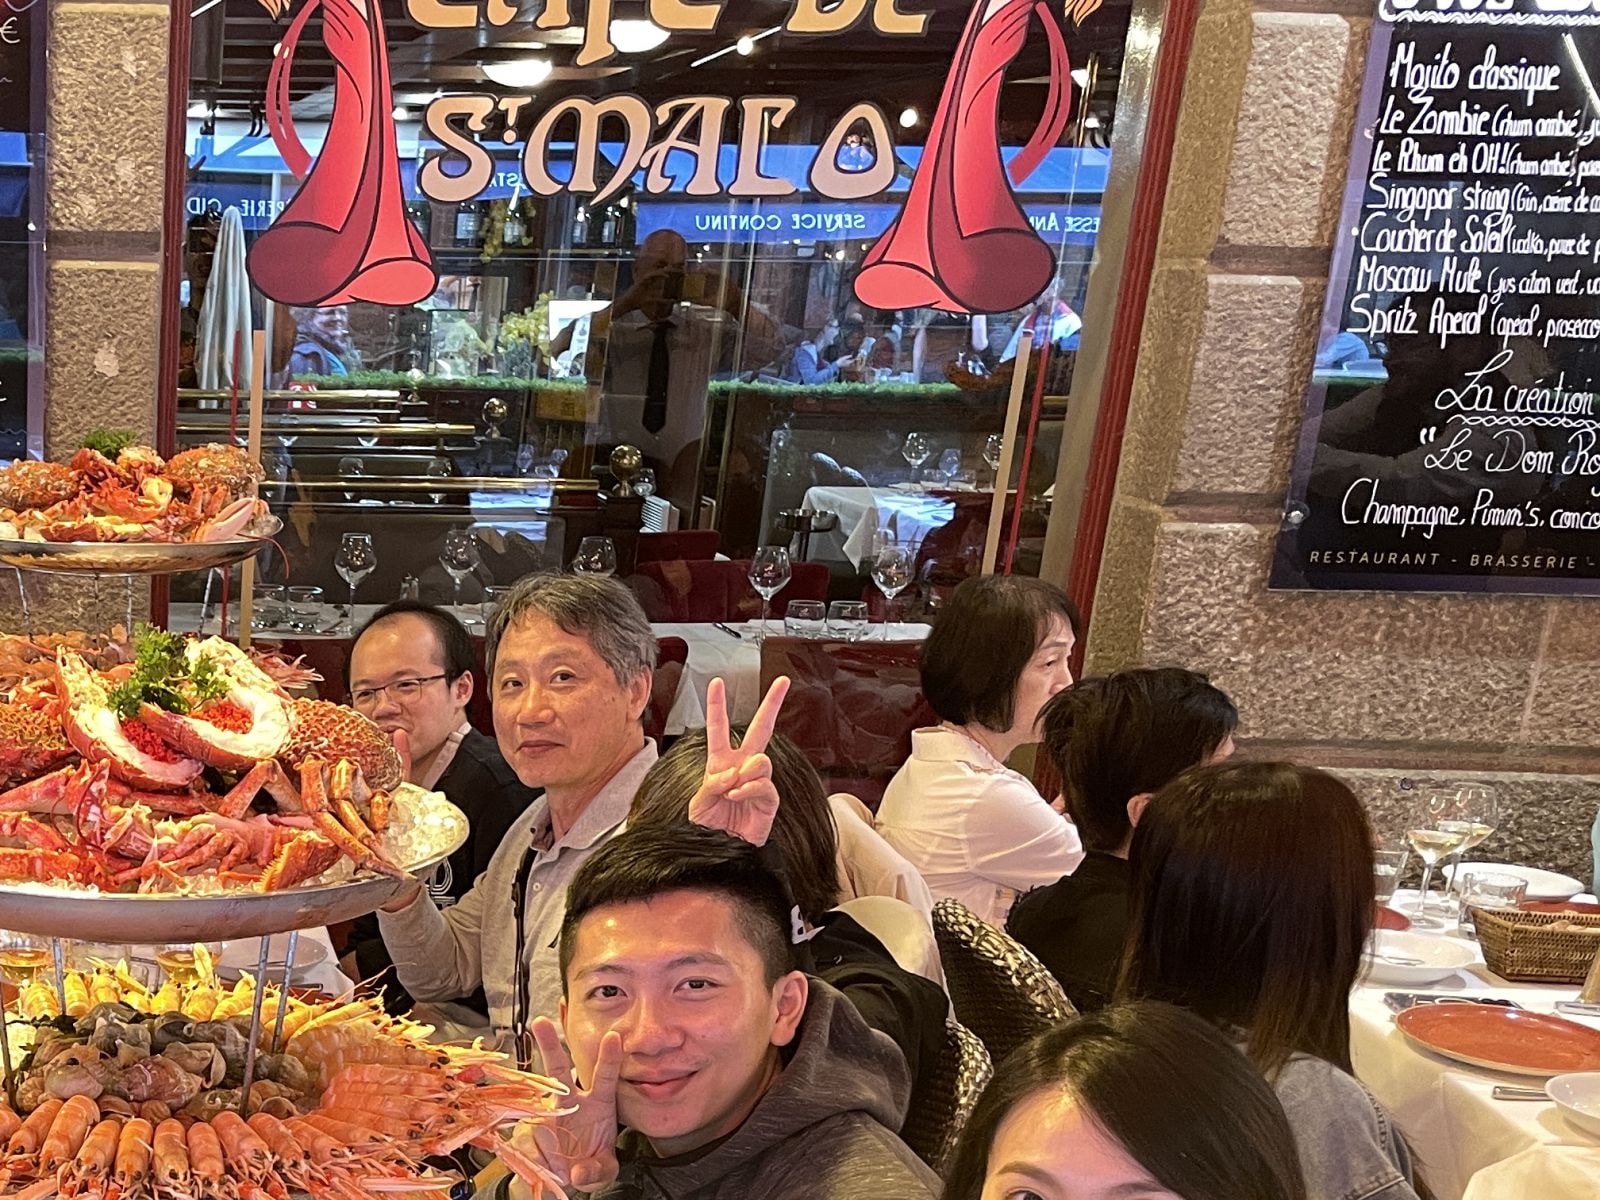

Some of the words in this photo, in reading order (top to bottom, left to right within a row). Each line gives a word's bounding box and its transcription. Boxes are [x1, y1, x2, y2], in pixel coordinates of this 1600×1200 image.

[1390, 41, 1460, 99] Mojito
[1468, 44, 1560, 106] classique
[1380, 95, 1405, 134] Le
[1407, 96, 1490, 135] Zombie
[1397, 137, 1444, 173] Rhum
[1357, 255, 1432, 293] Moscow
[1439, 256, 1482, 293] Mule
[1346, 293, 1418, 344] Spritz
[1429, 294, 1488, 349] Aperol
[1435, 350, 1513, 412] La
[1504, 371, 1594, 415] création
[1486, 429, 1552, 475] Dom
[1309, 551, 1441, 566] RESTAURANT
[1470, 555, 1578, 569] BRASSERIE
